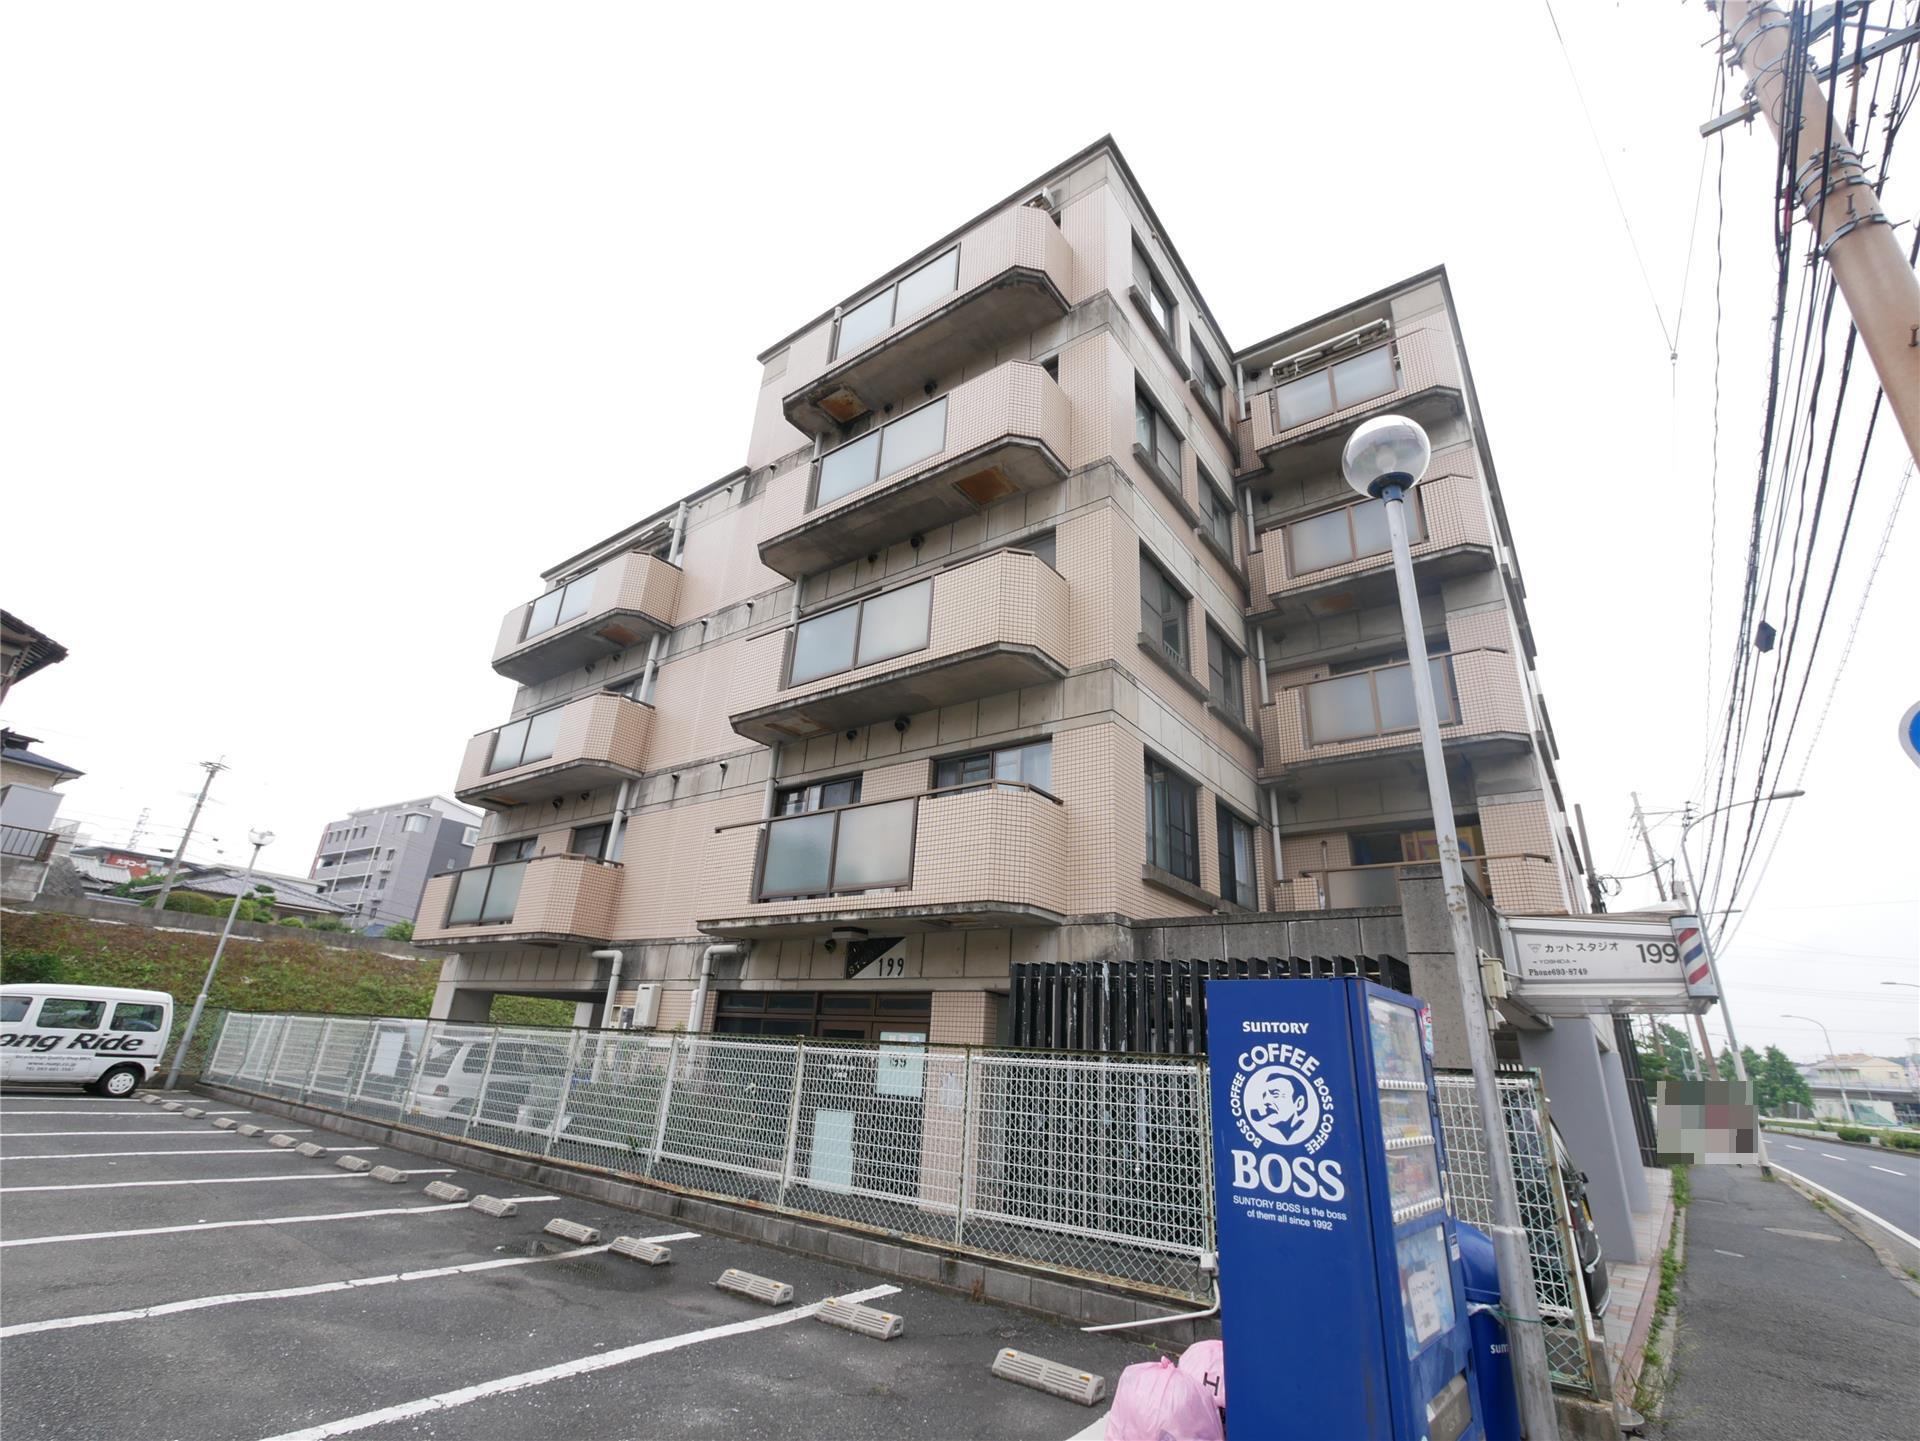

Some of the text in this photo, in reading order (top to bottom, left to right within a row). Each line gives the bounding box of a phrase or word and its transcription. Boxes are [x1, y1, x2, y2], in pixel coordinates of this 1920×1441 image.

[1545, 942, 1619, 953] カットスタジオ
[1636, 943, 1679, 964] 199
[879, 958, 905, 977] 199
[1242, 1021, 1309, 1034] SUNTORY
[66, 1033, 144, 1051] Ride
[1238, 1043, 1320, 1077] COFFEE
[1230, 1072, 1263, 1149] BOSS COFFEE
[1304, 1077, 1334, 1155] BOSS COFFEE
[1231, 1149, 1345, 1202] BOSS
[1233, 1195, 1347, 1221] SUNTORY BOSS is the boss
[1247, 1209, 1333, 1231] of them all since 1992
